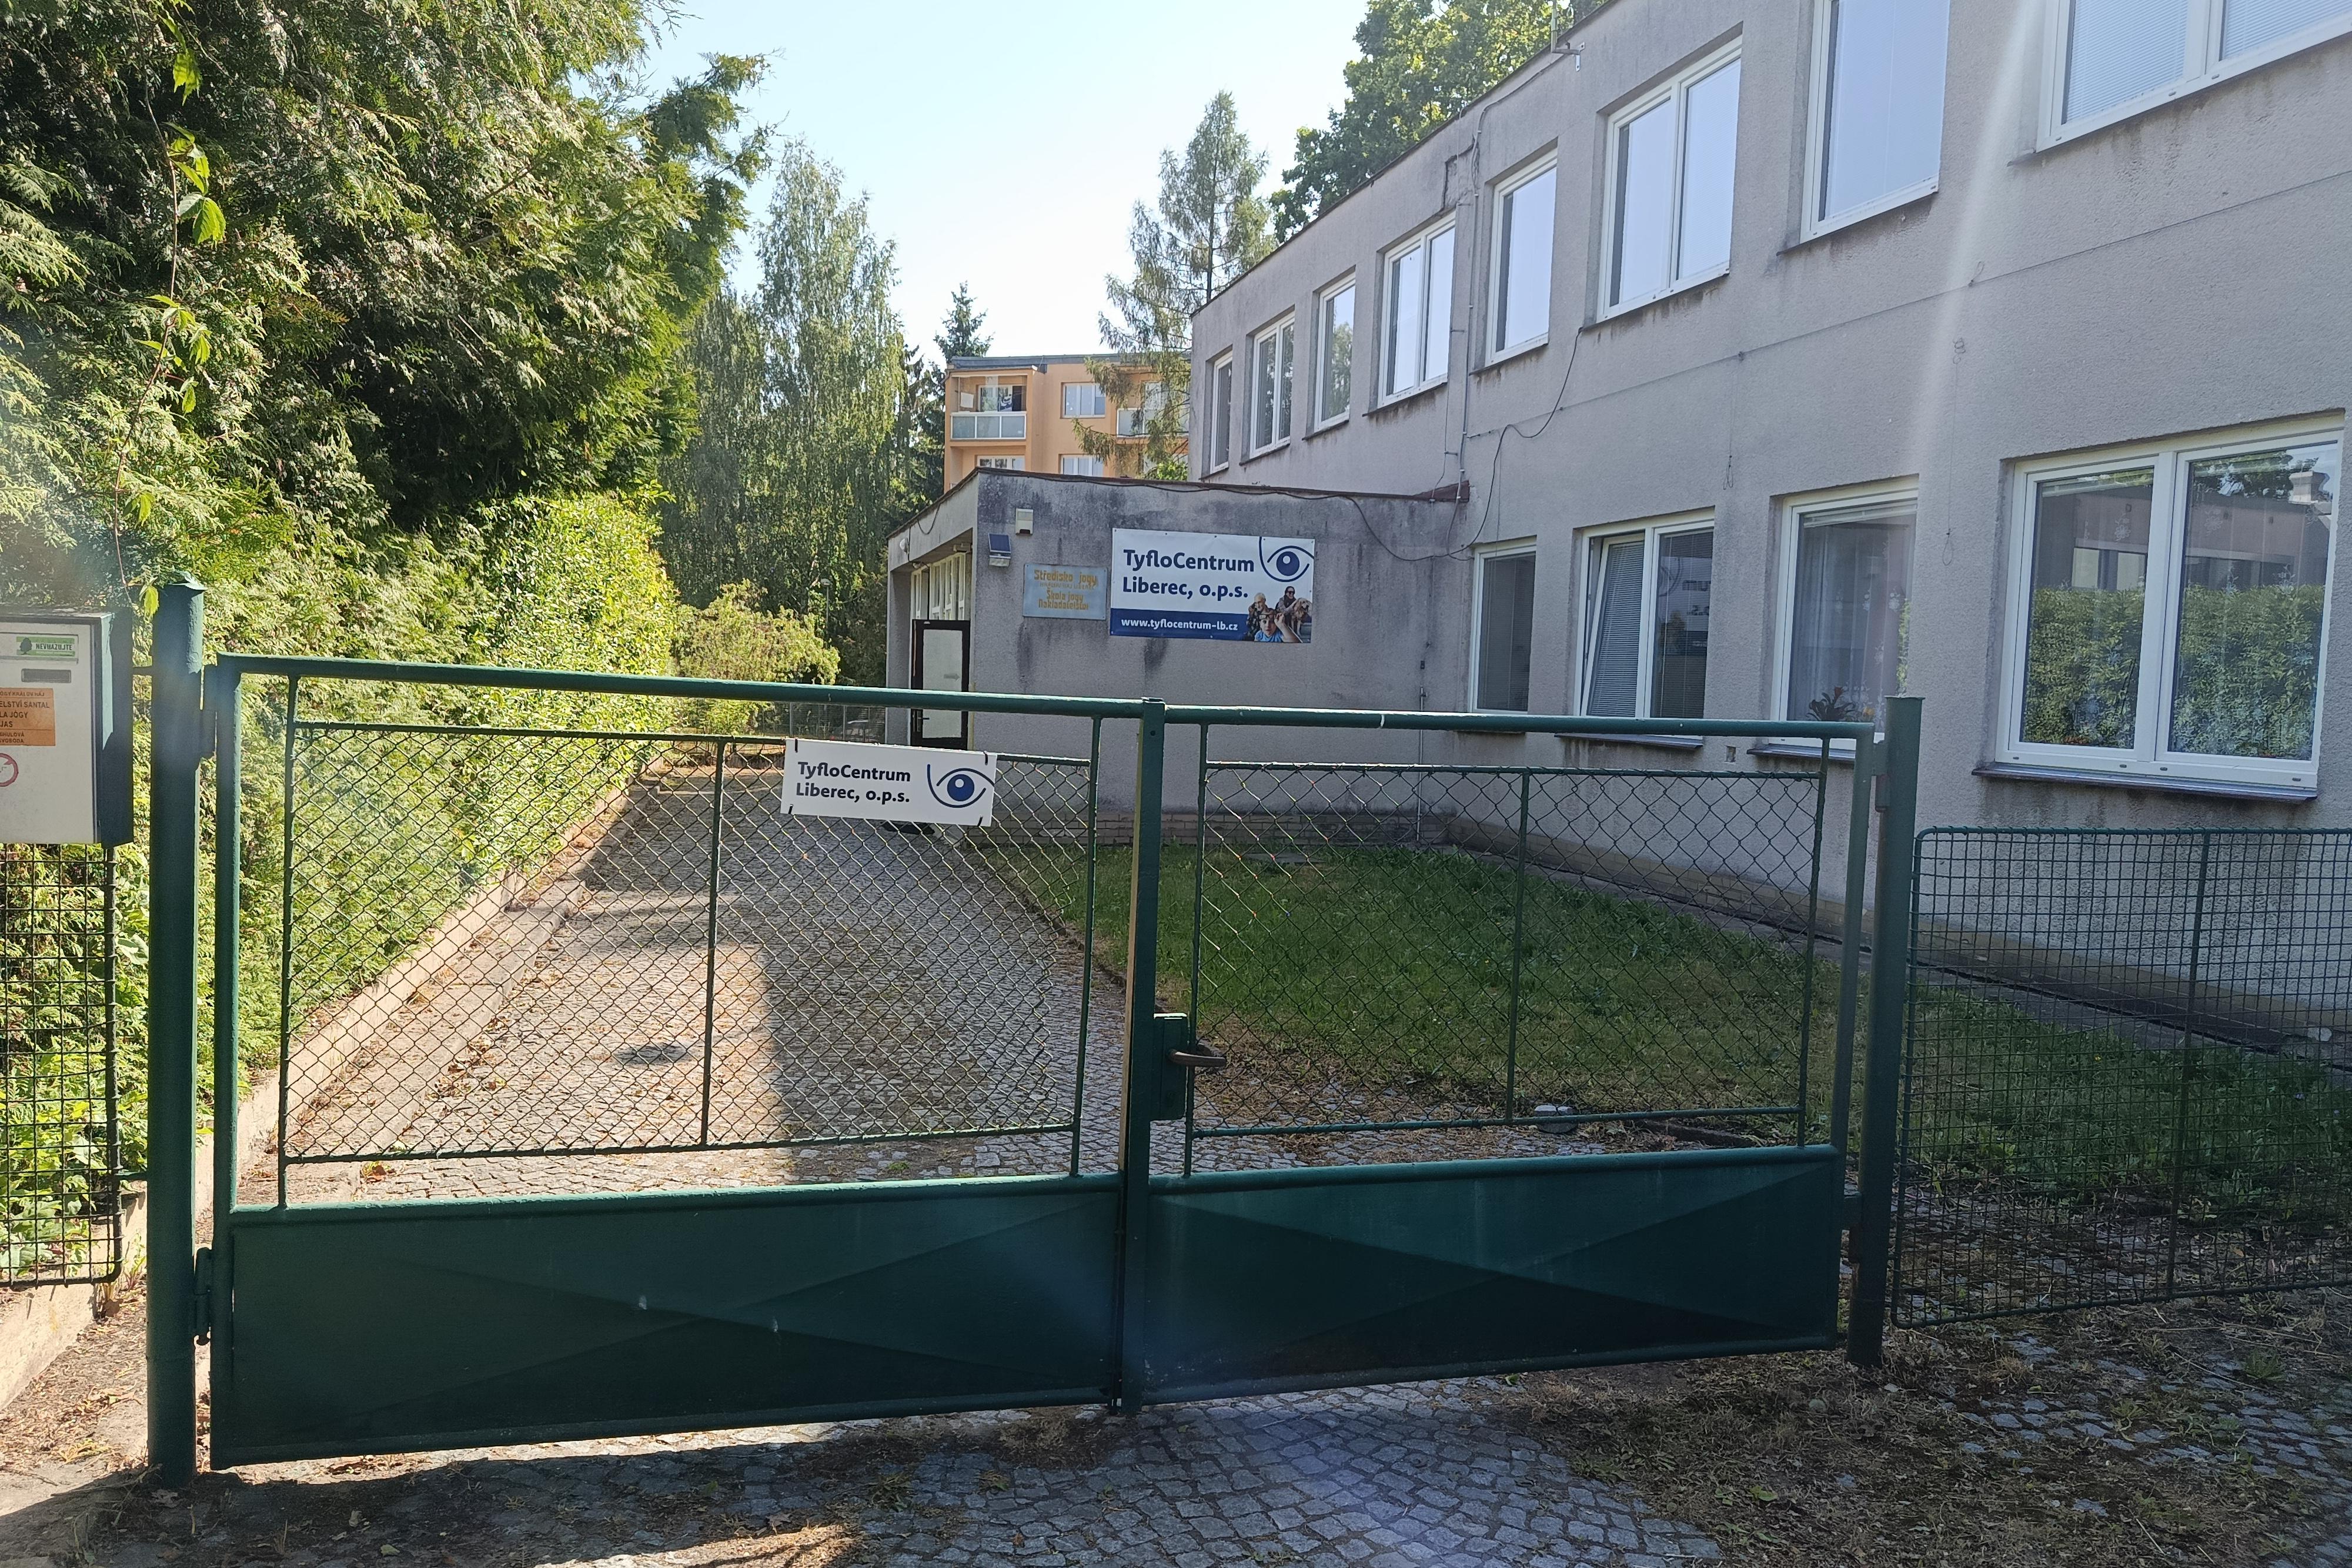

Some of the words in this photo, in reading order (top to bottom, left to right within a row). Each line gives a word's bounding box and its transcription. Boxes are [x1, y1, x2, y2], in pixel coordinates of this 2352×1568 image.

[1123, 549, 1254, 572] TyfloCentrum
[1123, 576, 1193, 600] Liberec,
[1199, 584, 1248, 601] o.p.s.
[1121, 618, 1238, 631] www.tyflocentrum-lb.cz
[797, 761, 911, 782] TyfloCentrum
[796, 782, 860, 803] Liberec,
[866, 790, 910, 805] o.p.s.
